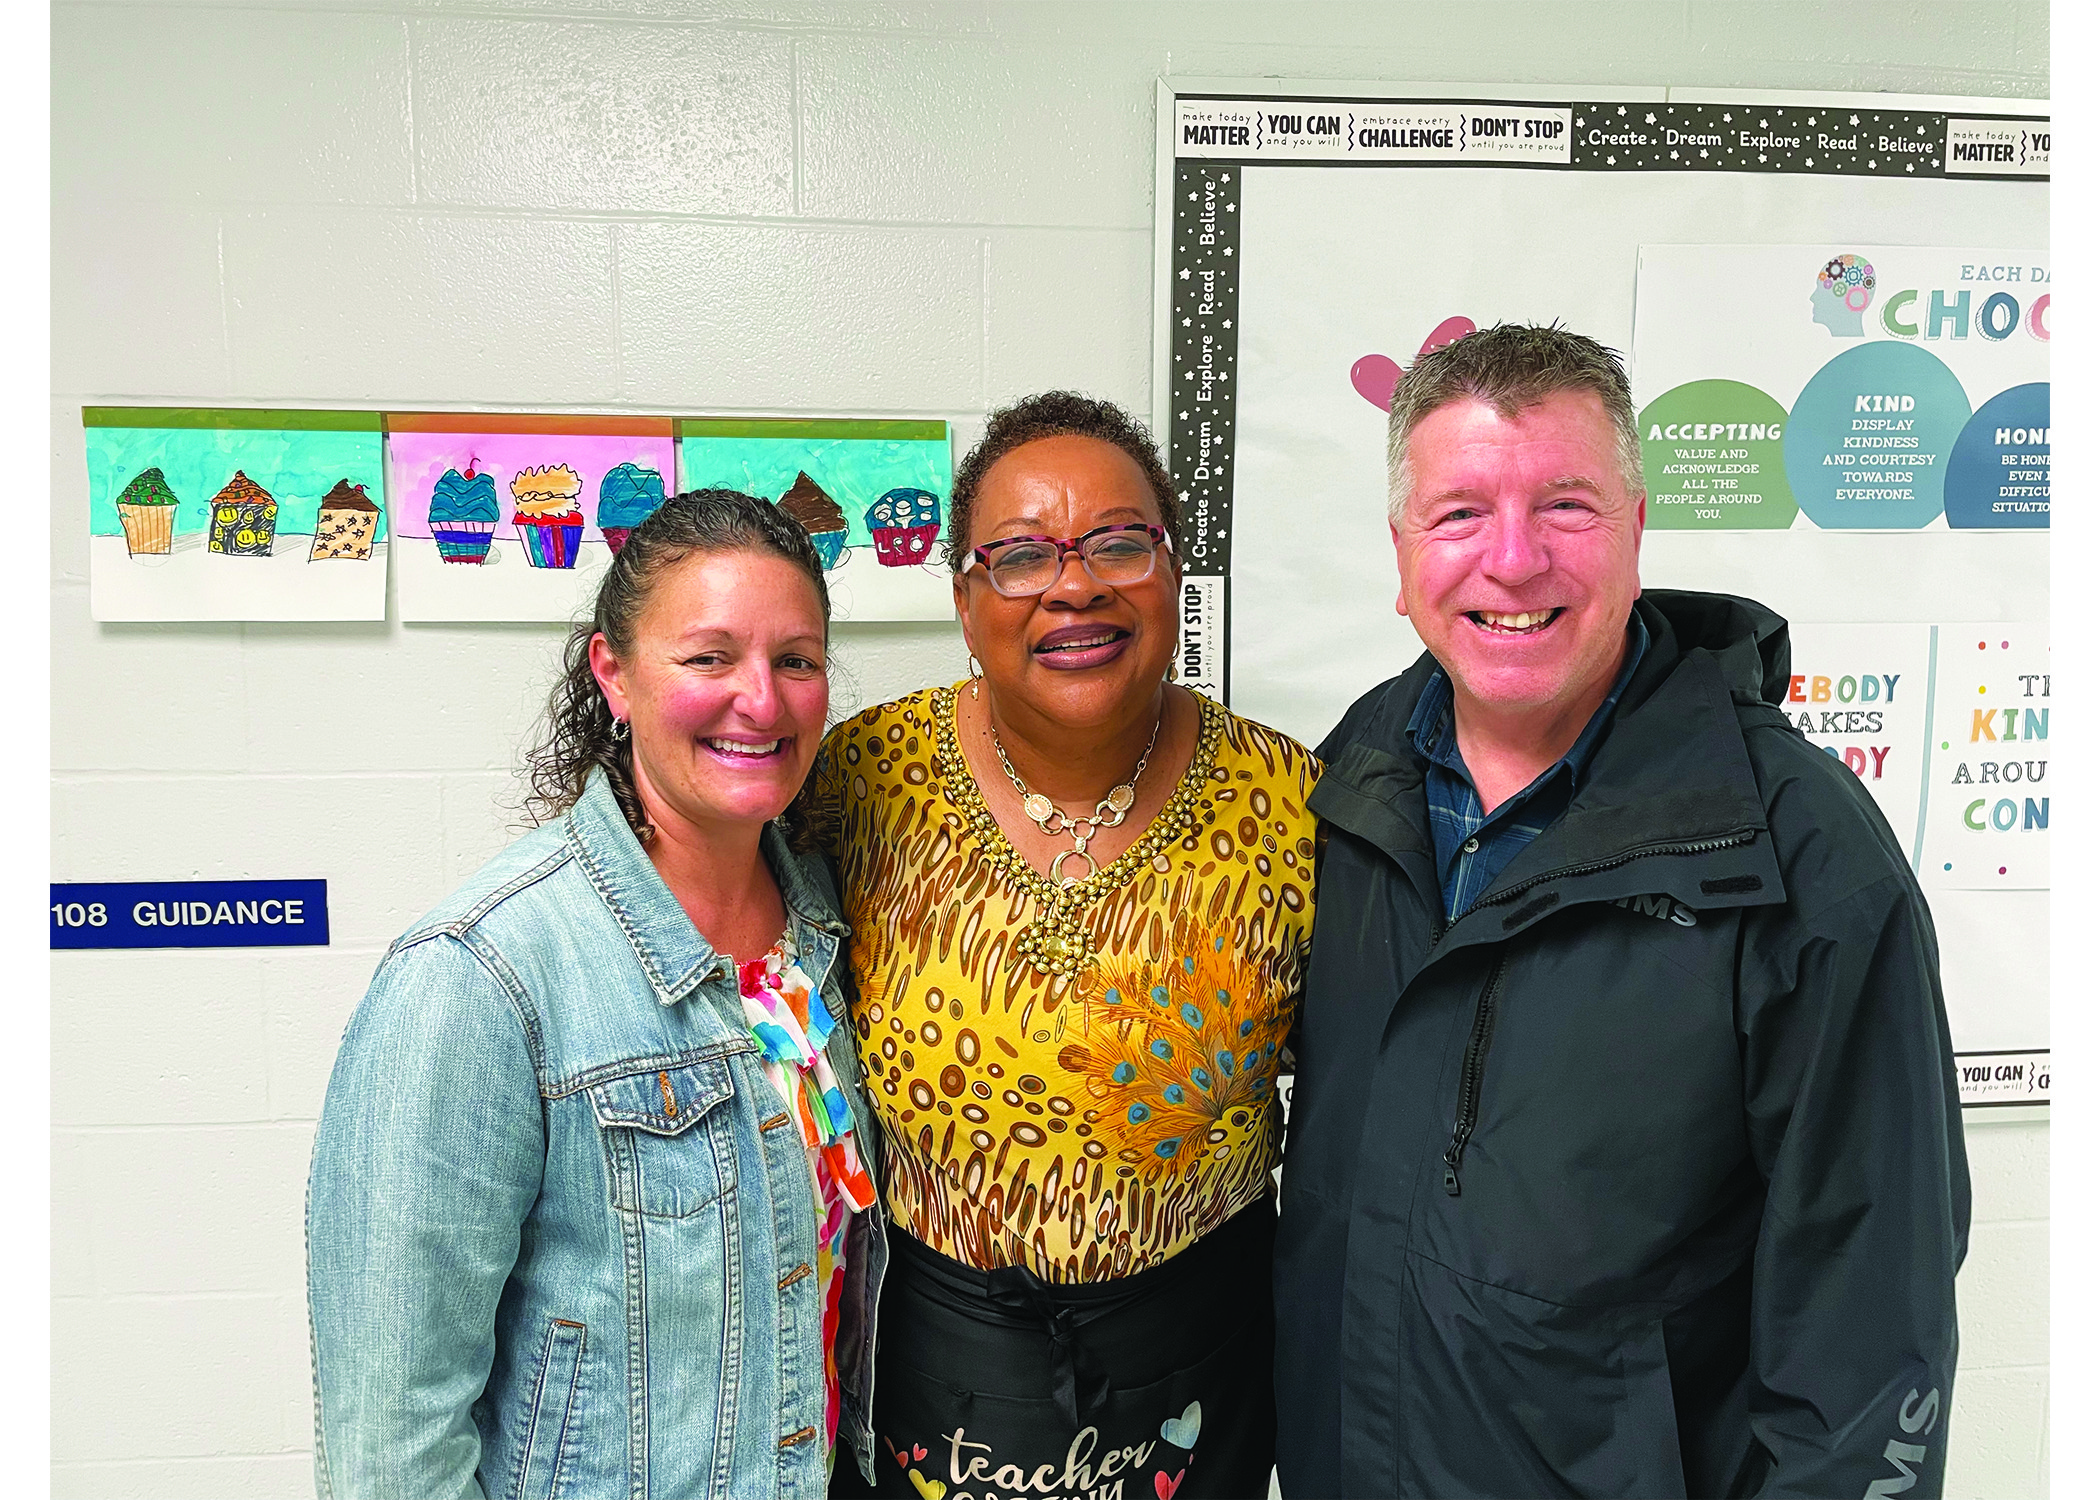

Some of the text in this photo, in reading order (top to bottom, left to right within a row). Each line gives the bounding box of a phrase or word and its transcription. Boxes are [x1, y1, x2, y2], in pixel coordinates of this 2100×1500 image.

[1183, 112, 1251, 125] make today
[1267, 115, 1340, 135] YOU CAN
[1362, 116, 1450, 128] embrace every
[1471, 118, 1564, 139] DON'T STOP
[1184, 125, 1250, 146] MATTER
[1359, 128, 1454, 148] CHALLENGE
[1588, 129, 1934, 154] Create Dream Explore Read Believe
[1954, 130, 2016, 143] make today
[1267, 137, 1340, 149] and you will
[1471, 141, 1495, 149] until
[1537, 144, 1565, 152] proud
[1953, 143, 2014, 162] MATTER
[2030, 154, 2049, 162] and
[1960, 265, 2022, 282] EACH
[1192, 181, 1216, 558] Create Dream Explore Read Believe
[1854, 395, 1915, 412] KIND
[1852, 420, 1914, 430] DISPLAY
[1647, 423, 1781, 441] ACCEPTING
[1843, 437, 1919, 448] KINDNESS
[1674, 449, 1748, 459] VALUE AND
[1822, 454, 1936, 465] AND COURTESY
[2001, 455, 2018, 465] BE
[1662, 464, 1760, 474] ACKNOWLEDGE
[1842, 472, 1913, 483] TOWARDS
[2009, 471, 2043, 481] EVEN
[1682, 479, 1738, 489] ALL THE
[1836, 489, 1915, 500] EVERYONE.
[1999, 486, 2050, 497] DIFFICU
[1656, 494, 1762, 504] PEOPLE AROUND
[1992, 502, 2050, 512] SITUATIO
[1695, 509, 1721, 519] YOU.
[1205, 583, 1215, 611] proud
[1184, 584, 1201, 678] DON'T STOP
[1207, 635, 1215, 651] you
[1781, 711, 1883, 733] AKES
[1969, 708, 2050, 743] KIN
[1951, 761, 2048, 784] AROU
[1962, 797, 2050, 832] CON
[51, 900, 304, 927] 108 GUIDANCE
[1963, 1066, 1991, 1083] YOU
[1995, 1065, 2023, 1081] CAN
[1982, 1085, 1999, 1094] you
[2004, 1082, 2023, 1090] will
[941, 1427, 1156, 1492] teacher
